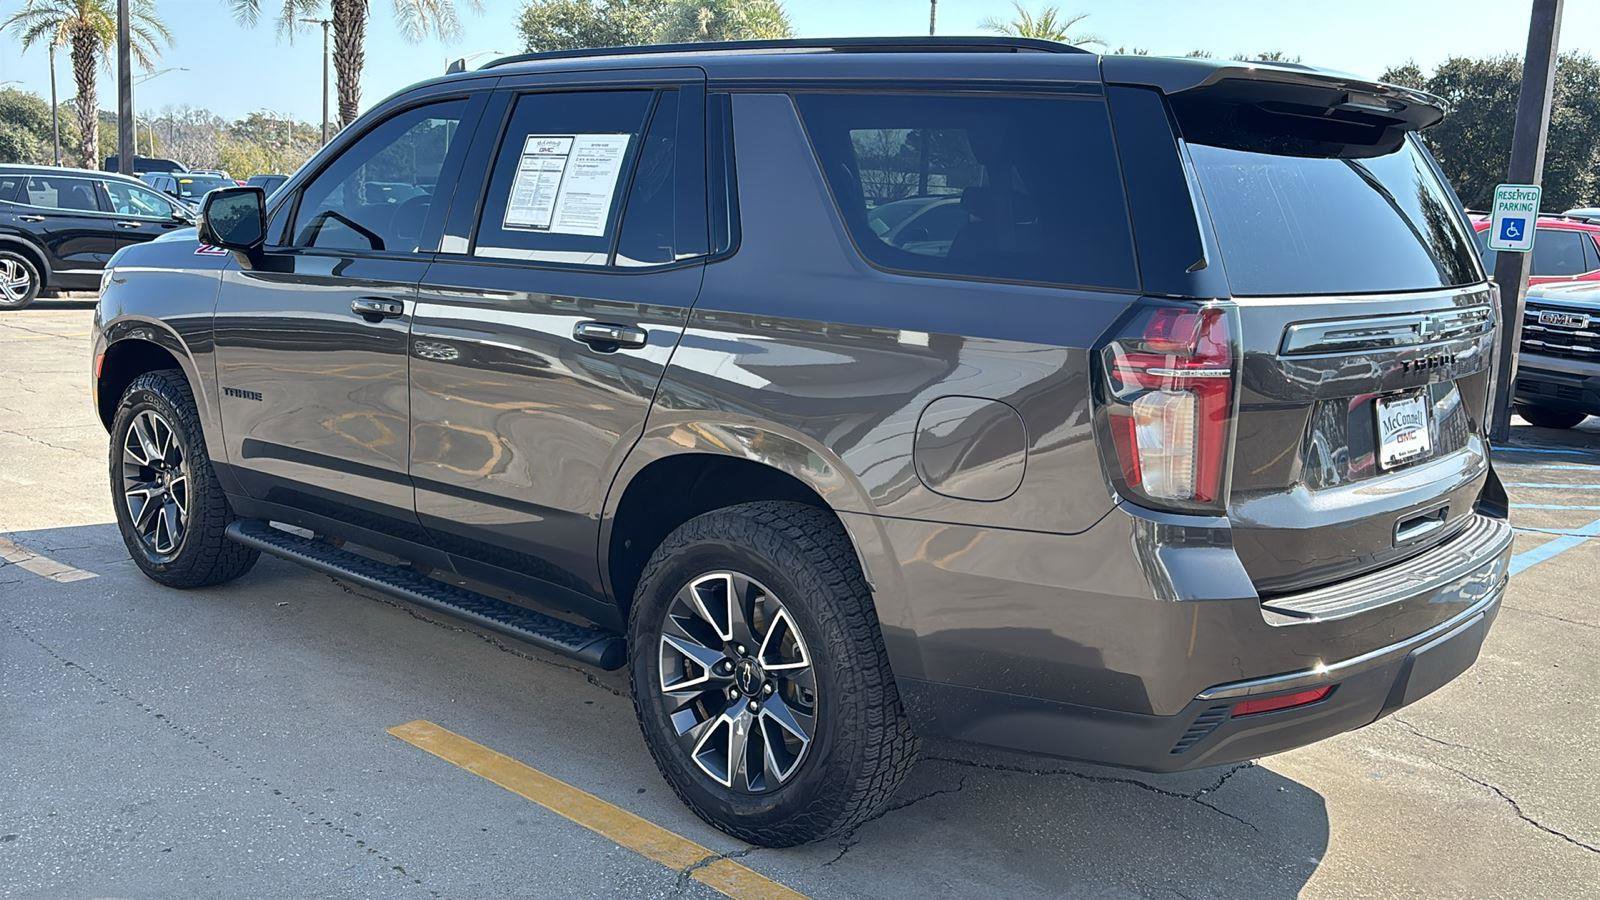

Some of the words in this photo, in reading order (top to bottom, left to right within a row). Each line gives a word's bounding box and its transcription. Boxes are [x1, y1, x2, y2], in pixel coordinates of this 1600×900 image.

[1497, 191, 1538, 201] RESERVED
[1498, 202, 1534, 212] PARKING
[1540, 311, 1586, 327] GMC
[222, 386, 263, 401] TAHOE
[1382, 409, 1424, 436] McConnell
[1396, 430, 1417, 444] GMC
